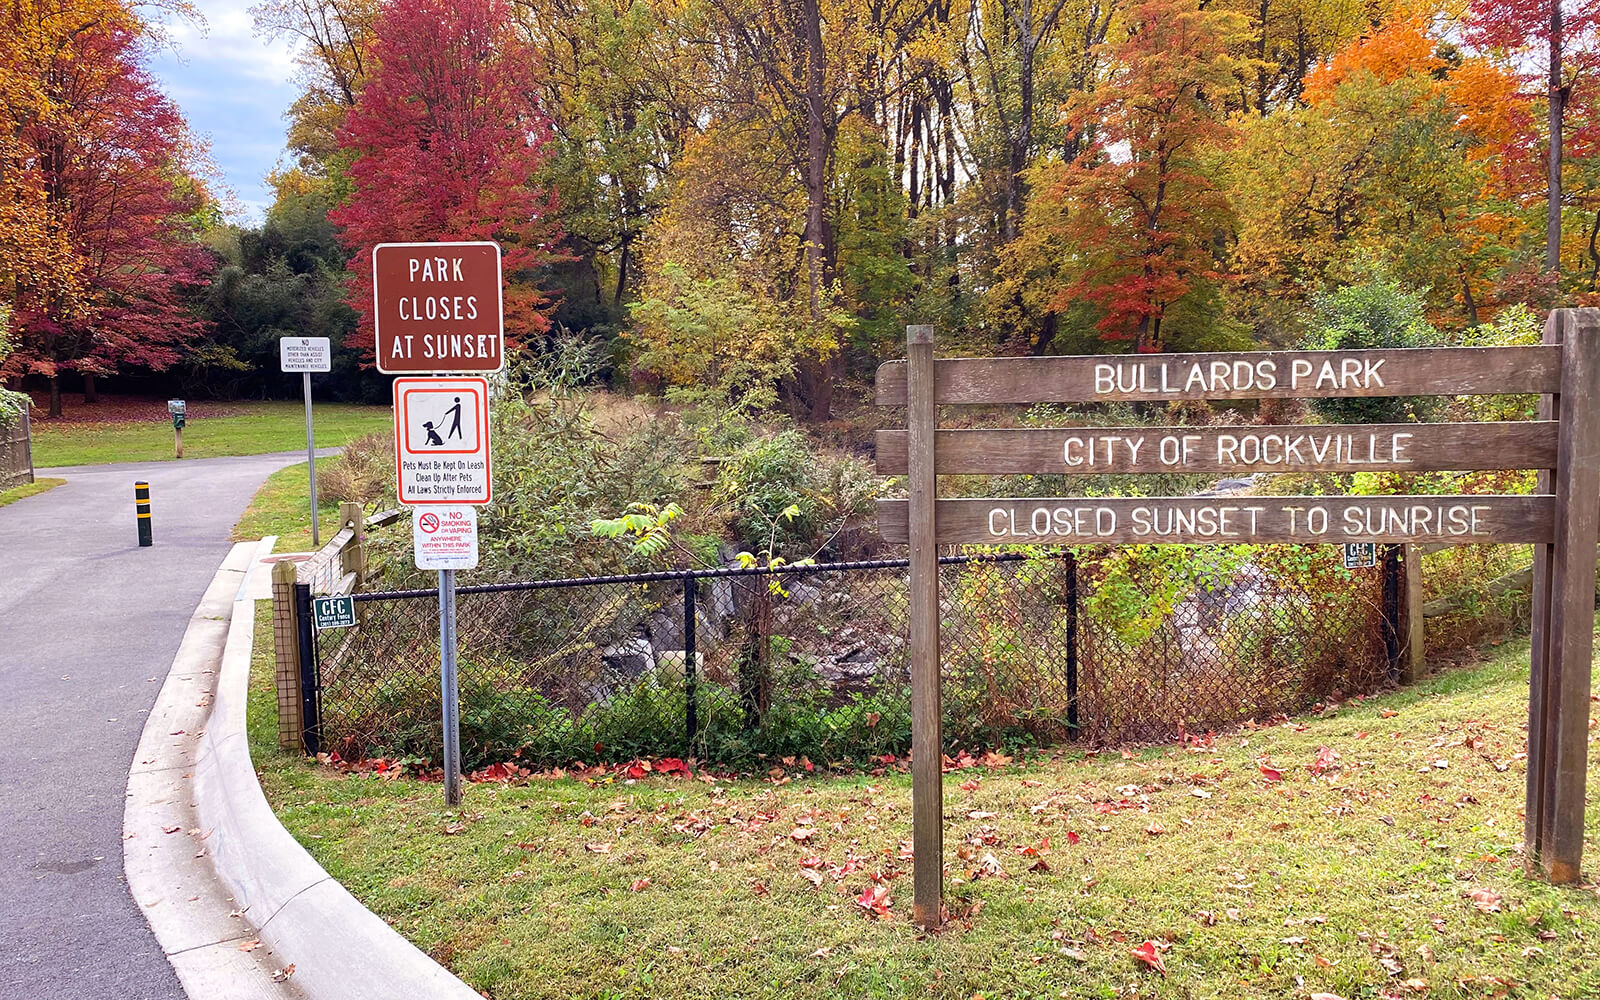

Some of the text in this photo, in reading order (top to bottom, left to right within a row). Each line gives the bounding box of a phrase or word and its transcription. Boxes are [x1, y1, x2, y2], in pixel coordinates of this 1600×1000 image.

[409, 258, 464, 282] PARK
[399, 296, 478, 320] CLOSES
[391, 334, 497, 359] AT SUNSET
[1094, 358, 1386, 394] BULLARDS PARK
[1063, 432, 1414, 467] CITY OF ROCKVILLE
[403, 460, 484, 471] Pets Must Be Kept On Leash
[416, 472, 472, 484] Clean Up After Pets
[417, 486, 432, 494] Laws
[434, 485, 454, 495] Strictly
[456, 484, 482, 494] Enforced
[449, 512, 462, 520] NO
[987, 505, 1493, 537] CLOSED SUNSET TO SUNRISE
[322, 600, 346, 616] CFC
